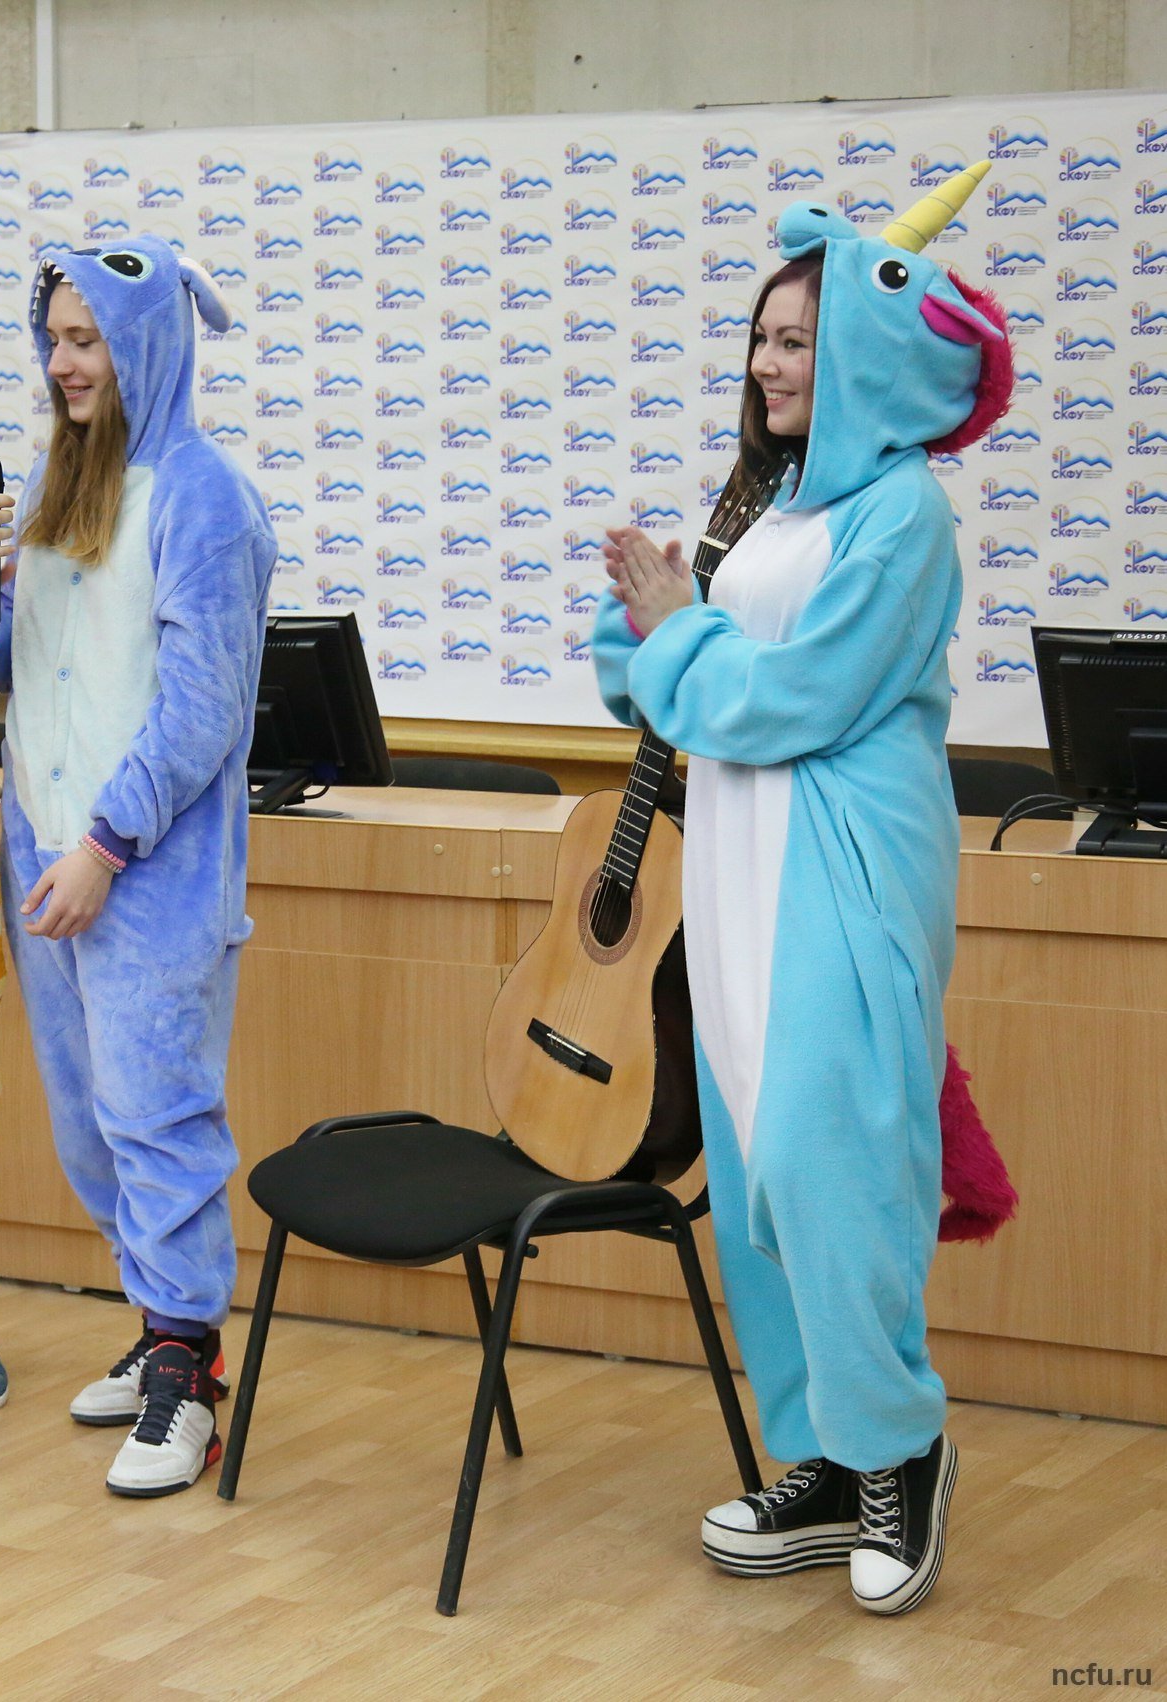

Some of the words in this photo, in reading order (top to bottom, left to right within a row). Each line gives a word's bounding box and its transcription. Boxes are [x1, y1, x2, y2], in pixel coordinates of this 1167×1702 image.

[988, 150, 1018, 159] СКФУ
[838, 156, 866, 165] СКФУ
[702, 161, 730, 170] СКФУ
[440, 170, 466, 179] СКФУ
[564, 166, 591, 175] СКФУ
[198, 176, 222, 186] СКФУ
[313, 173, 338, 183] СКФУ
[1059, 172, 1090, 181] СКФУ
[767, 182, 796, 192] СКФУ
[910, 178, 940, 187] СКФУ
[500, 190, 526, 200] СКФУ
[631, 187, 659, 196] СКФУ
[254, 197, 278, 206] СКФУ
[375, 194, 400, 203] СКФУ
[986, 207, 1017, 217] СКФУ
[1134, 205, 1166, 215] СКФУ
[702, 216, 729, 225] СКФУ
[439, 222, 466, 232] СКФУ
[564, 222, 591, 231] СКФУ
[198, 227, 222, 237] СКФУ
[313, 227, 338, 237] СКФУ
[1058, 232, 1089, 242] СКФУ
[500, 246, 526, 255] СКФУ
[631, 241, 658, 251] СКФУ
[254, 250, 278, 259] СКФУ
[375, 247, 400, 256] СКФУ
[985, 267, 1016, 276] СКФУ
[1132, 265, 1163, 275] СКФУ
[440, 277, 466, 286] СКФУ
[564, 277, 590, 287] СКФУ
[701, 273, 729, 282] СКФУ
[314, 281, 339, 290] СКФУ
[1056, 292, 1087, 301] СКФУ
[375, 301, 401, 310] СКФУ
[500, 301, 526, 310] СКФУ
[631, 298, 658, 307] СКФУ
[255, 303, 280, 312] СКФУ
[701, 329, 728, 339] СКФУ
[1130, 326, 1162, 336] СКФУ
[200, 333, 224, 342] СКФУ
[315, 334, 339, 343] СКФУ
[440, 331, 466, 341] СКФУ
[563, 333, 590, 342] СКФУ
[255, 356, 280, 365] СКФУ
[375, 354, 401, 364] СКФУ
[500, 356, 526, 365] СКФУ
[631, 353, 657, 363] СКФУ
[1054, 351, 1085, 361] СКФУ
[199, 385, 223, 394] СКФУ
[314, 387, 339, 397] СКФУ
[440, 386, 465, 395] СКФУ
[564, 388, 590, 397] СКФУ
[700, 386, 728, 395] СКФУ
[1129, 386, 1160, 396] СКФУ
[255, 409, 279, 418] СКФУ
[375, 408, 400, 417] СКФУ
[500, 410, 526, 420] СКФУ
[630, 409, 657, 418] СКФУ
[1053, 410, 1083, 420] СКФУ
[315, 440, 340, 449] СКФУ
[441, 440, 466, 449] СКФУ
[563, 443, 590, 452] СКФУ
[699, 442, 727, 451] СКФУ
[982, 442, 1011, 453] СКФУ
[1127, 445, 1159, 455] СКФУ
[257, 461, 281, 470] СКФУ
[376, 461, 401, 470] СКФУ
[500, 464, 526, 474] СКФУ
[630, 464, 657, 474] СКФУ
[1051, 469, 1082, 479] СКФУ
[315, 493, 340, 502] СКФУ
[440, 493, 466, 503] СКФУ
[563, 498, 590, 507] СКФУ
[980, 501, 1011, 511] СКФУ
[1125, 505, 1157, 515] СКФУ
[376, 514, 401, 523] СКФУ
[500, 519, 526, 528] СКФУ
[1050, 528, 1080, 538] СКФУ
[315, 545, 340, 554] СКФУ
[440, 547, 466, 556] СКФУ
[563, 552, 590, 561] СКФУ
[979, 559, 1009, 568] СКФУ
[376, 567, 402, 576] СКФУ
[1124, 564, 1155, 574] СКФУ
[500, 572, 526, 582] СКФУ
[1048, 586, 1078, 596] СКФУ
[317, 596, 341, 605] СКФУ
[441, 600, 467, 609] СКФУ
[563, 605, 589, 614] СКФУ
[377, 620, 402, 628] СКФУ
[978, 616, 1006, 626] СКФУ
[500, 624, 526, 634] СКФУ
[441, 652, 466, 660] СКФУ
[563, 652, 589, 661] СКФУ
[377, 670, 402, 680] СКФУ
[976, 672, 1005, 682] СКФУ
[500, 676, 526, 685] СКФУ
